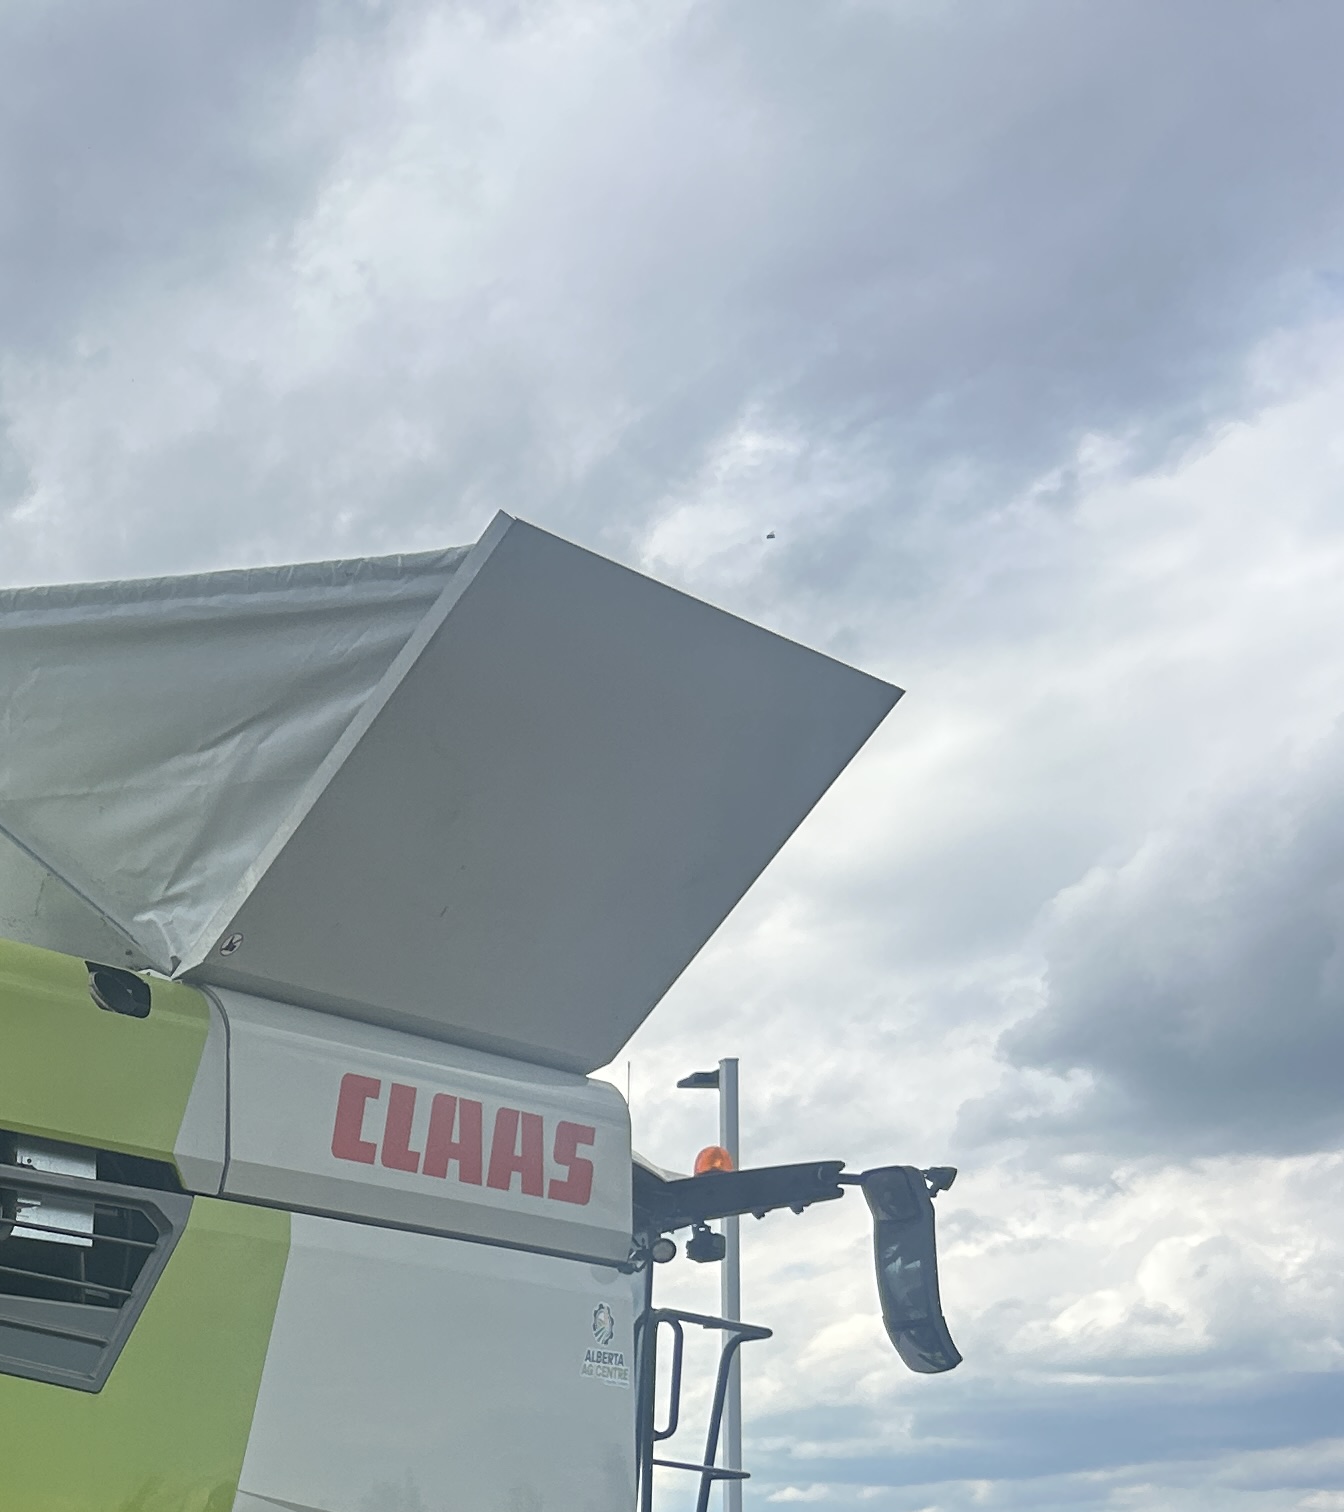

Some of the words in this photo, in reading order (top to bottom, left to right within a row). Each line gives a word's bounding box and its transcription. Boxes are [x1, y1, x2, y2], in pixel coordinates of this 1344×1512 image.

[331, 1072, 596, 1206] CLAAS
[584, 1349, 625, 1367] ALBERTA
[596, 1365, 629, 1381] CENTRE
